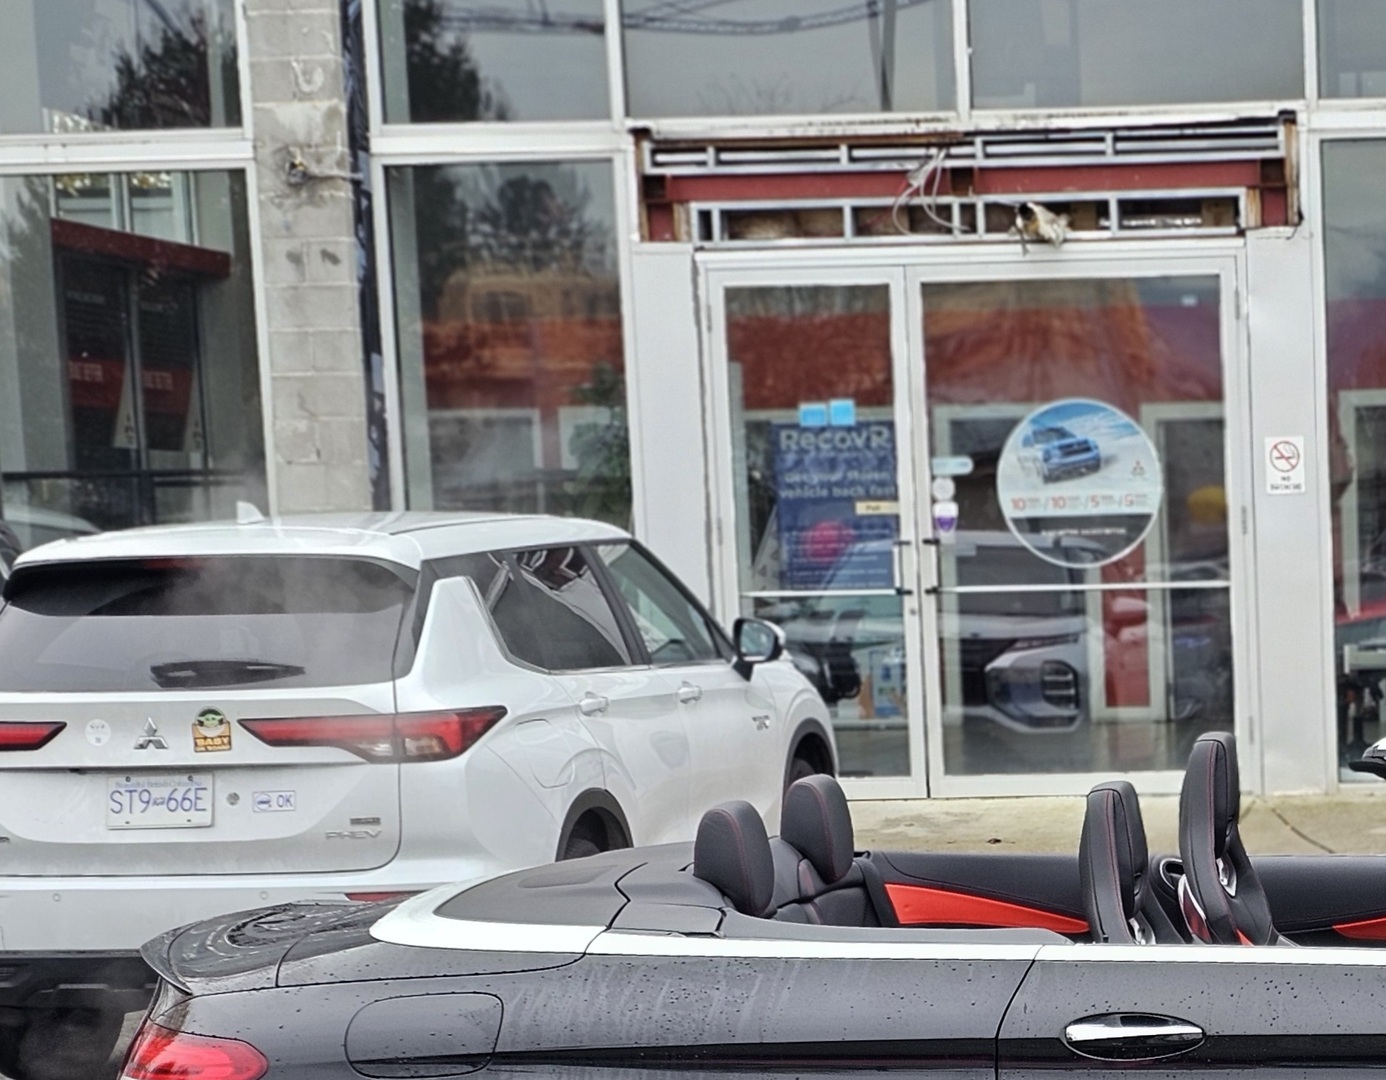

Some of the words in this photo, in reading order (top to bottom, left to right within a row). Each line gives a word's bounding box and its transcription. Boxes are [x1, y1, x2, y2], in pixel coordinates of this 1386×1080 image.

[779, 425, 891, 450] RecovR
[195, 737, 230, 748] BABY
[276, 794, 293, 808] OK
